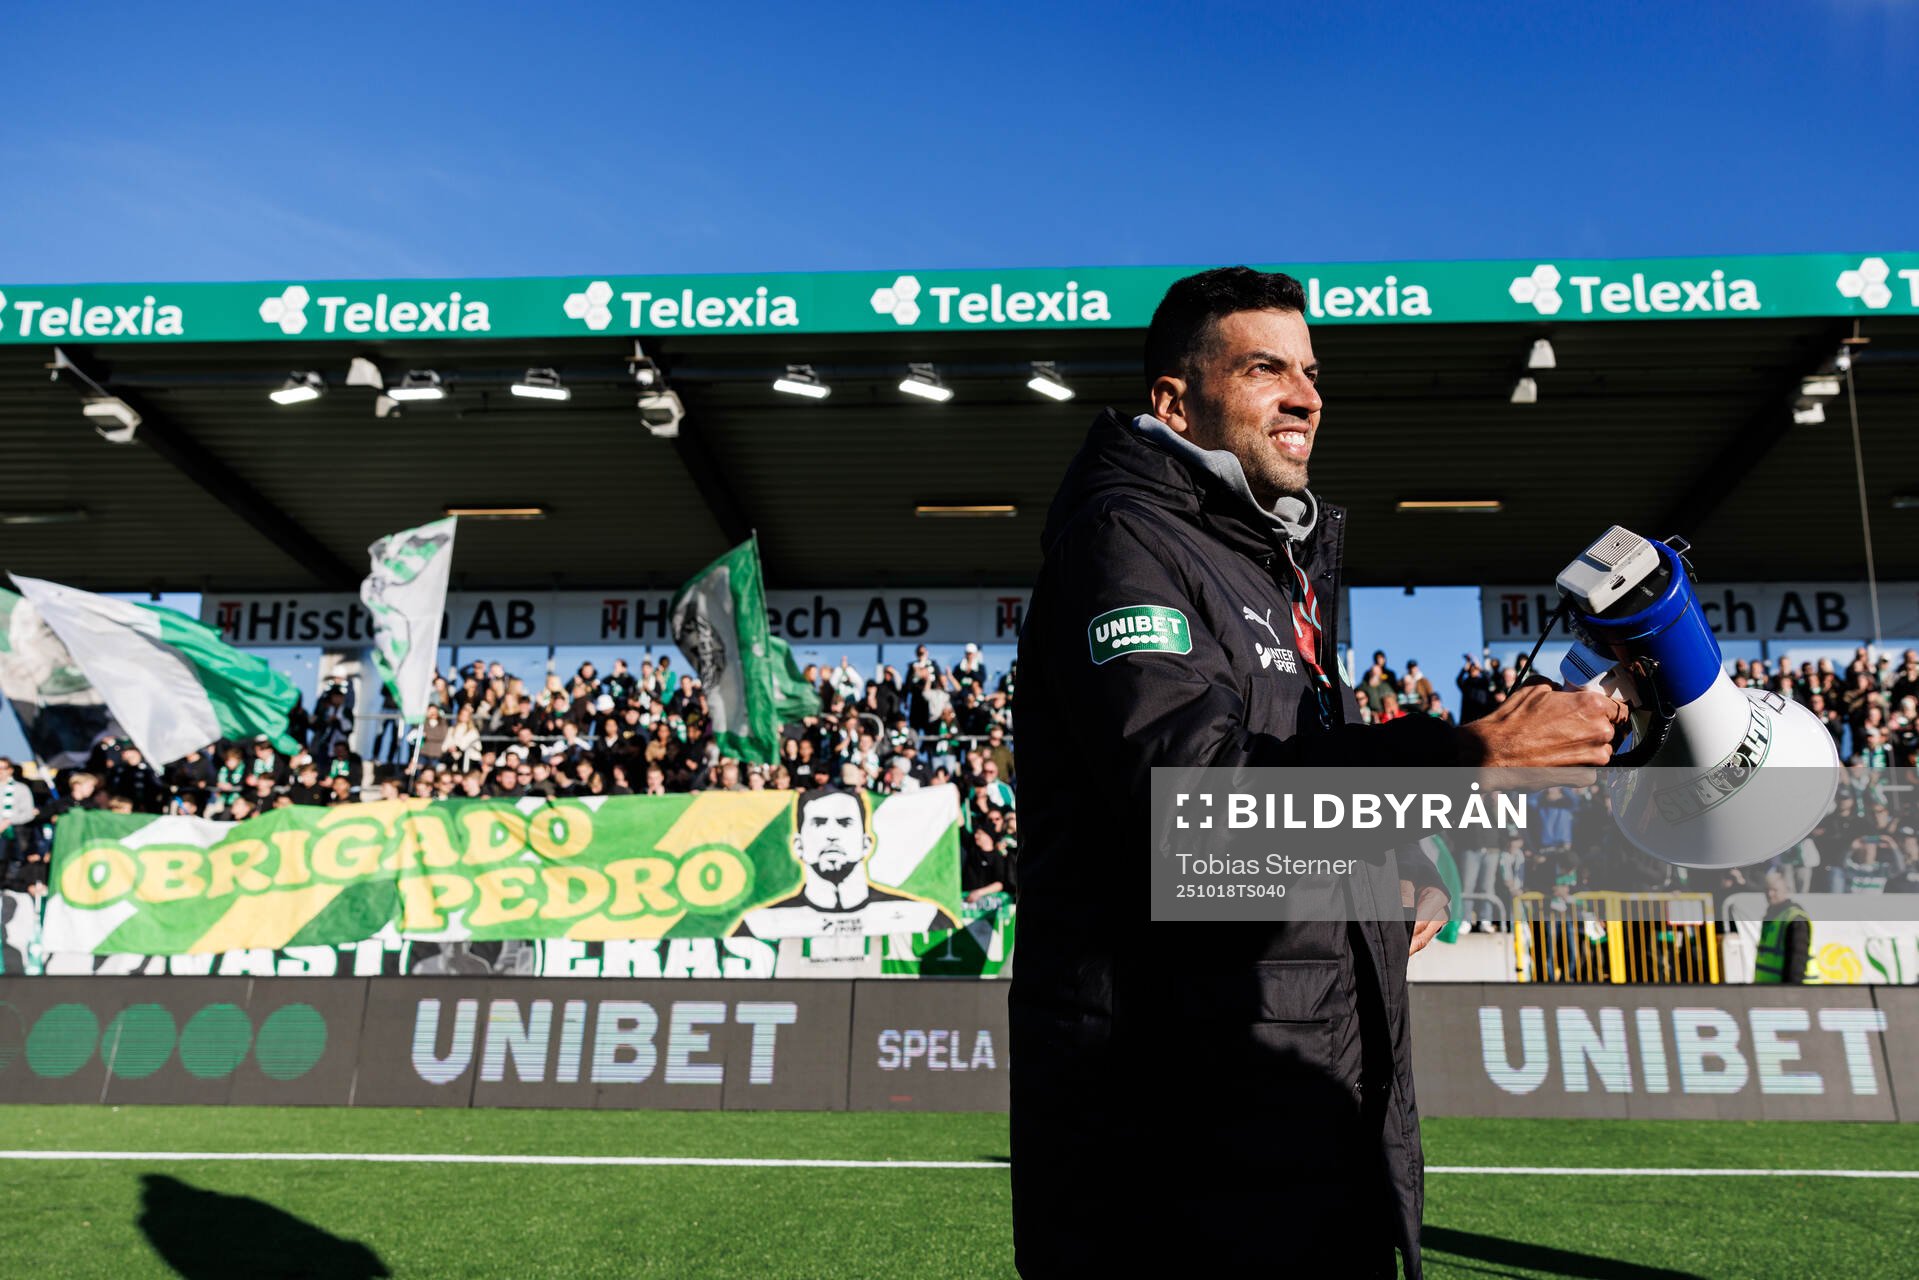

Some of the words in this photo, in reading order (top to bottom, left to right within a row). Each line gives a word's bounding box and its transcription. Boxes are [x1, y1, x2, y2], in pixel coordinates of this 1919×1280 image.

[621, 287, 799, 329] Telexia
[929, 281, 1112, 324] Telexia
[1308, 275, 1432, 317] lexia
[1570, 270, 1761, 313] Telexia
[14, 296, 184, 336] Telexia
[317, 292, 491, 334] Telexia
[466, 599, 536, 640] AB
[858, 598, 929, 638] AB
[1095, 614, 1182, 643] UNIBET
[1775, 592, 1850, 633] AB
[1273, 659, 1297, 674] SPORT
[61, 805, 593, 904] OBRIGADO
[399, 850, 747, 930] PEDRO
[412, 999, 798, 1085] UNIBET
[877, 1029, 996, 1072] SPELA
[1478, 1005, 1888, 1096] UNIBET
